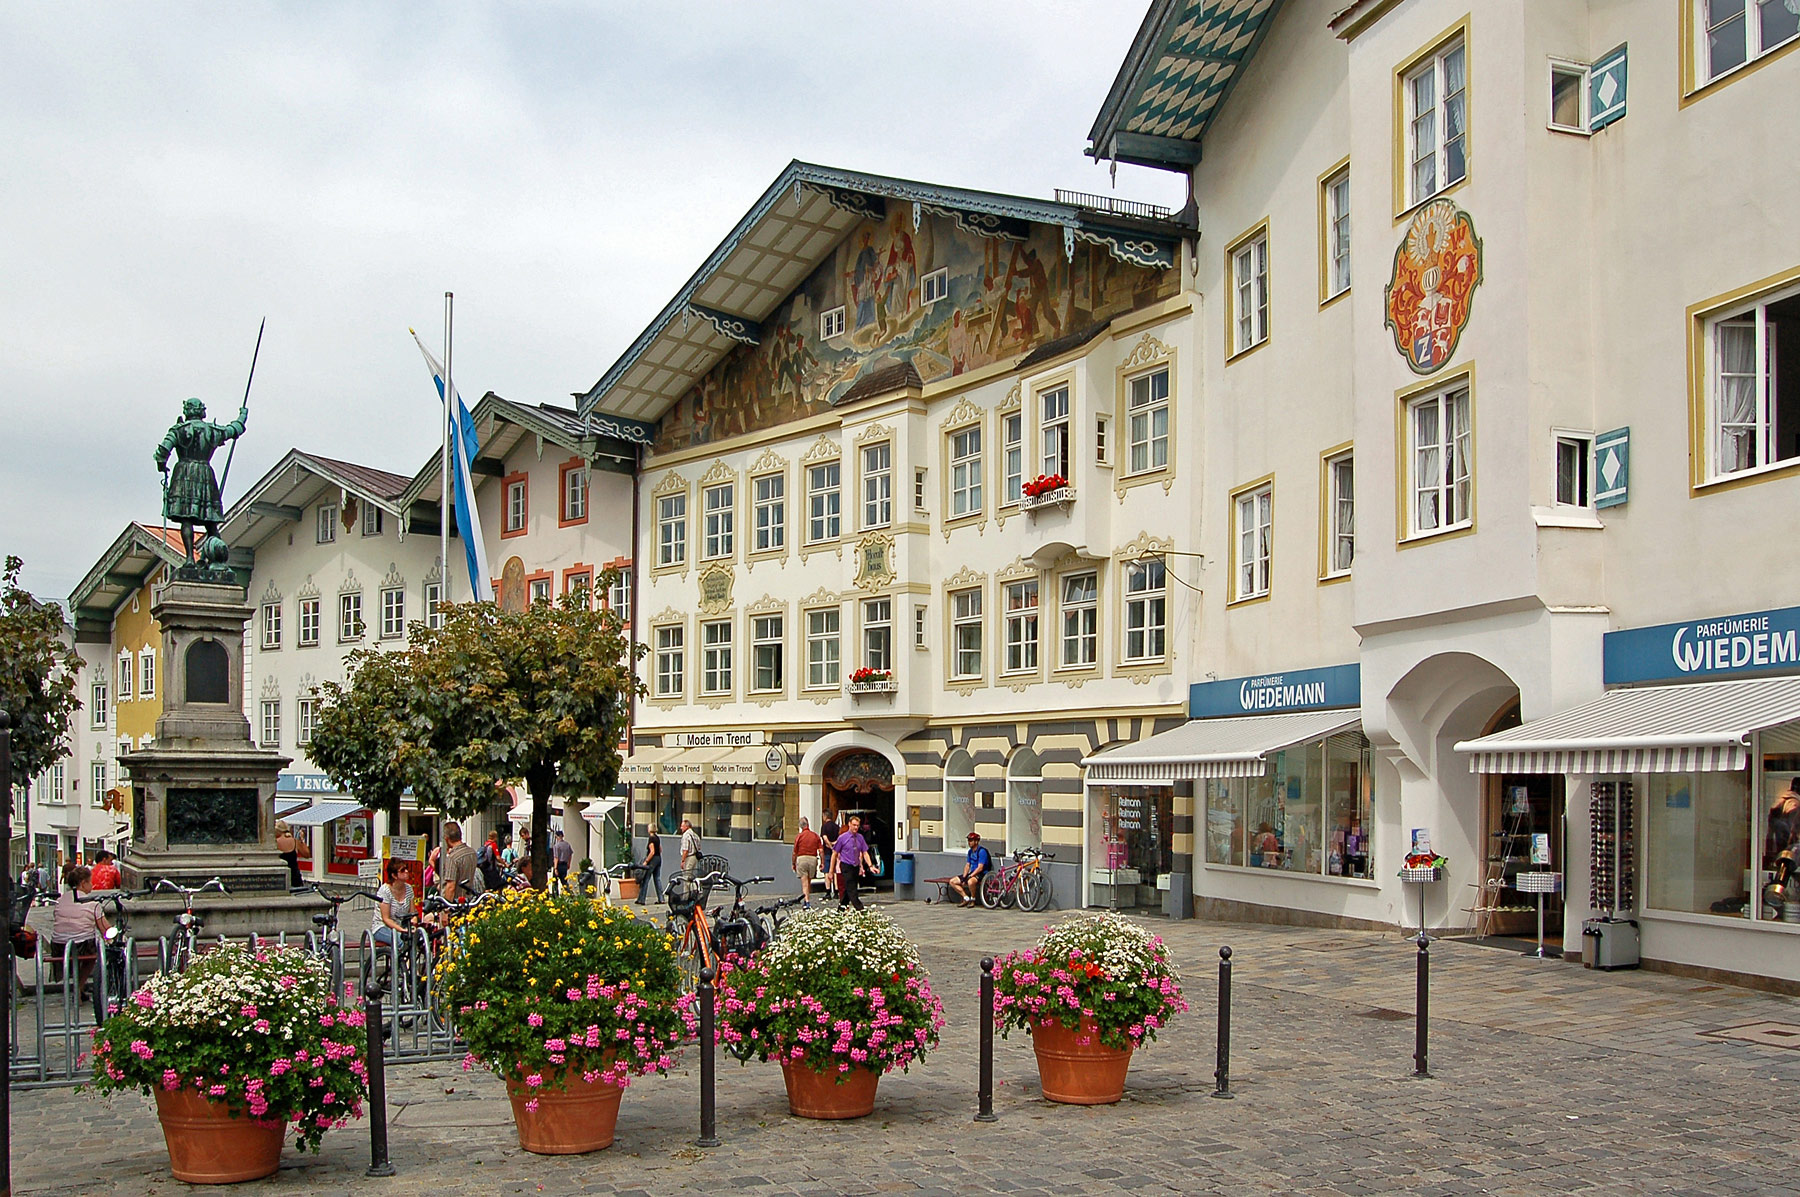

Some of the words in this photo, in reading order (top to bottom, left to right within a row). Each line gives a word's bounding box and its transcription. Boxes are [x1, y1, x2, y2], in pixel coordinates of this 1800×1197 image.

[1696, 616, 1769, 638] PARFÜMERIE
[1672, 627, 1800, 672] WIEDEM
[1250, 675, 1283, 688] PARFÜMERIE
[1240, 680, 1325, 710] WIEDEMANN
[687, 734, 711, 746] Mode
[713, 733, 724, 745] im
[726, 732, 752, 745] Trend
[619, 765, 630, 773] ode
[637, 765, 652, 773] Trend
[662, 765, 677, 773] Mode
[684, 764, 700, 773] Trend
[712, 765, 727, 773] Mode
[735, 765, 753, 773] Trend
